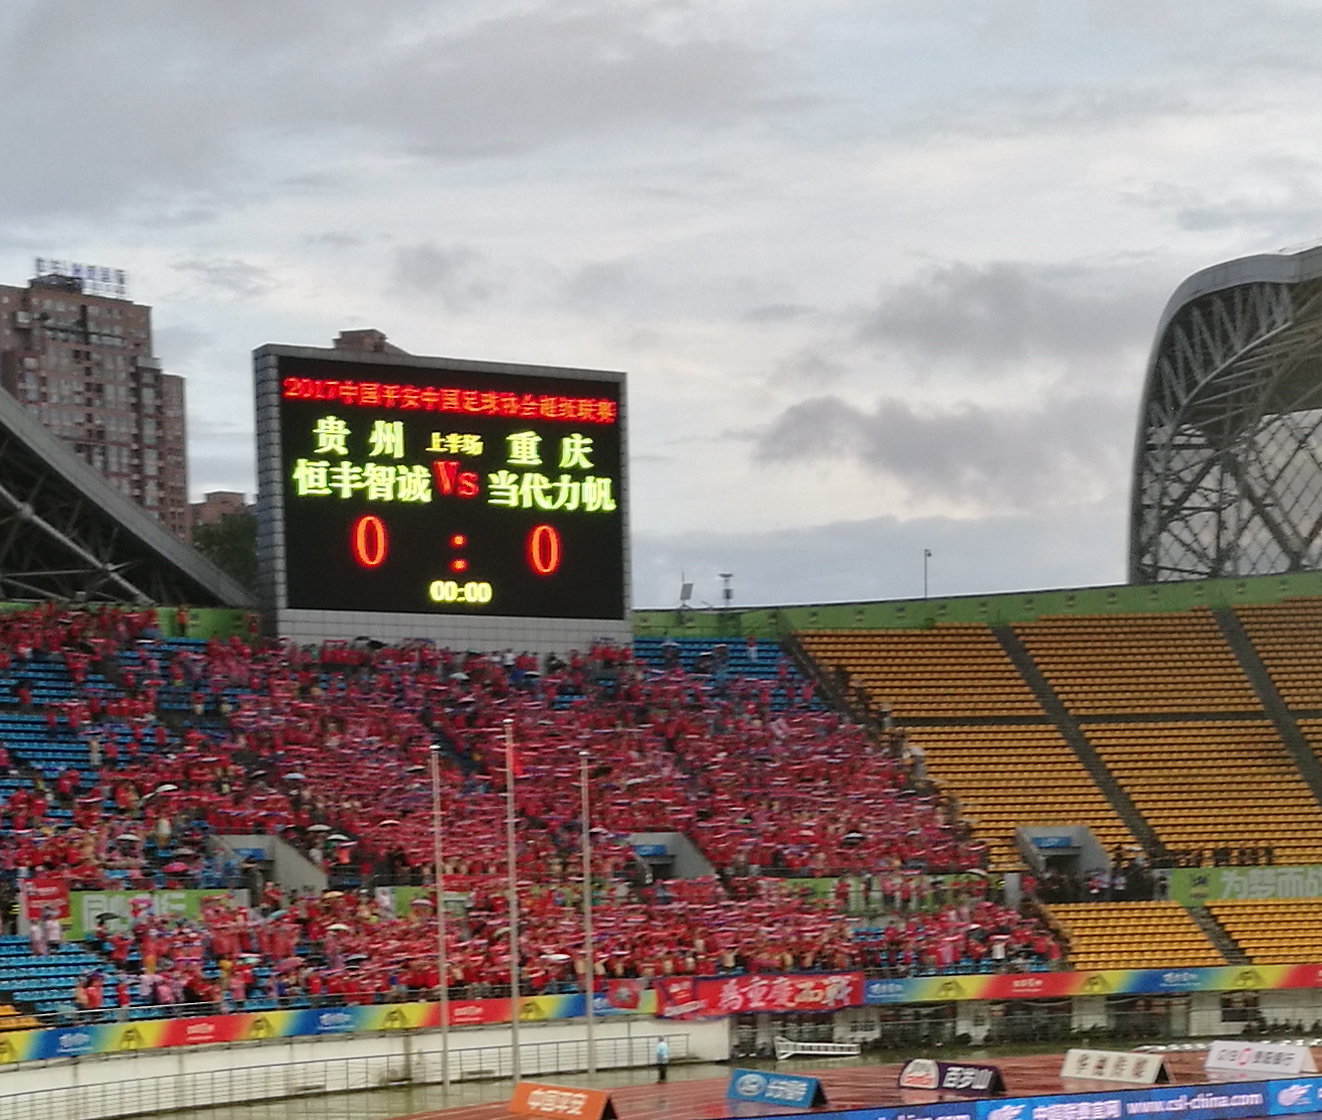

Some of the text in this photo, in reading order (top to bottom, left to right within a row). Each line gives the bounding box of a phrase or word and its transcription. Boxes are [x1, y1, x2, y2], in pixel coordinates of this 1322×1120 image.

[313, 416, 594, 469] 贵州 上半场 重庆
[293, 459, 432, 502] 恒丰智诚
[488, 470, 617, 512] 当代力帆
[354, 514, 387, 567] 0
[529, 524, 561, 575] 0
[429, 580, 493, 603] 00:00
[526, 1087, 589, 1115] 中国平安
[1125, 1092, 1264, 1115] www.csl-china.com
